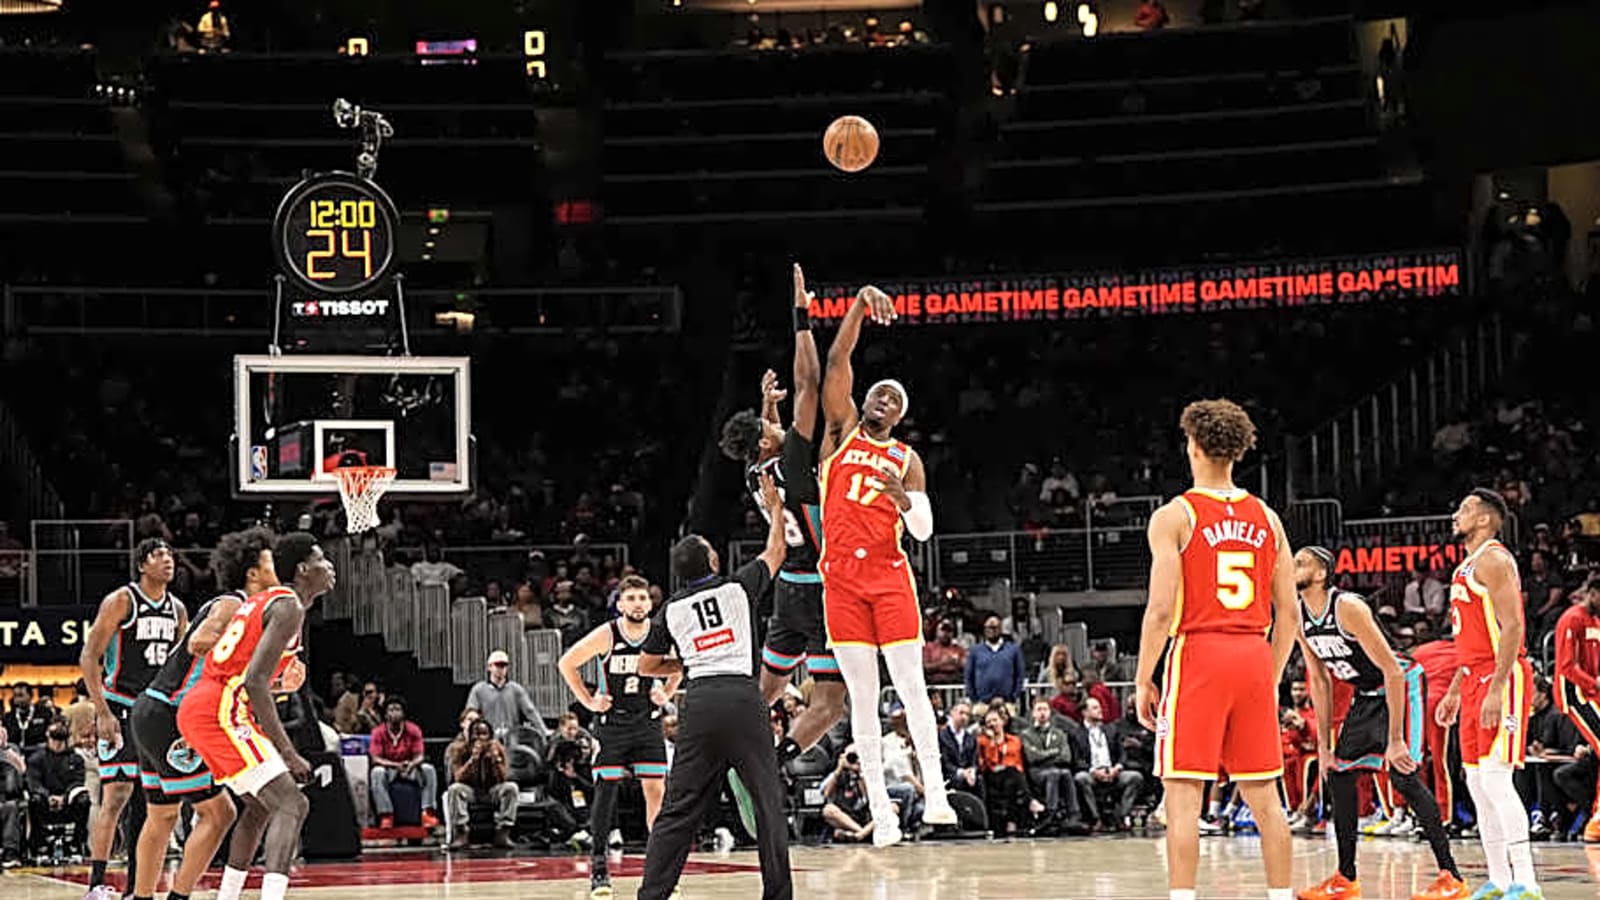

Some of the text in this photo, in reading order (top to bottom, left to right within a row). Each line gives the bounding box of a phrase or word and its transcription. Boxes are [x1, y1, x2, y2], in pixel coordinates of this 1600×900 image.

[310, 200, 375, 228] 12:00
[306, 229, 372, 279] 24
[319, 300, 389, 316] TISSOT
[924, 288, 1059, 315] GAMETIME
[1063, 281, 1196, 309] GAMETIME
[1200, 271, 1334, 301] GAMETIME
[846, 472, 886, 506] 17
[1202, 520, 1267, 549] DANIELS
[1216, 551, 1255, 609] 5
[692, 597, 723, 631] 19
[144, 642, 169, 666] 45
[624, 675, 641, 694] 2
